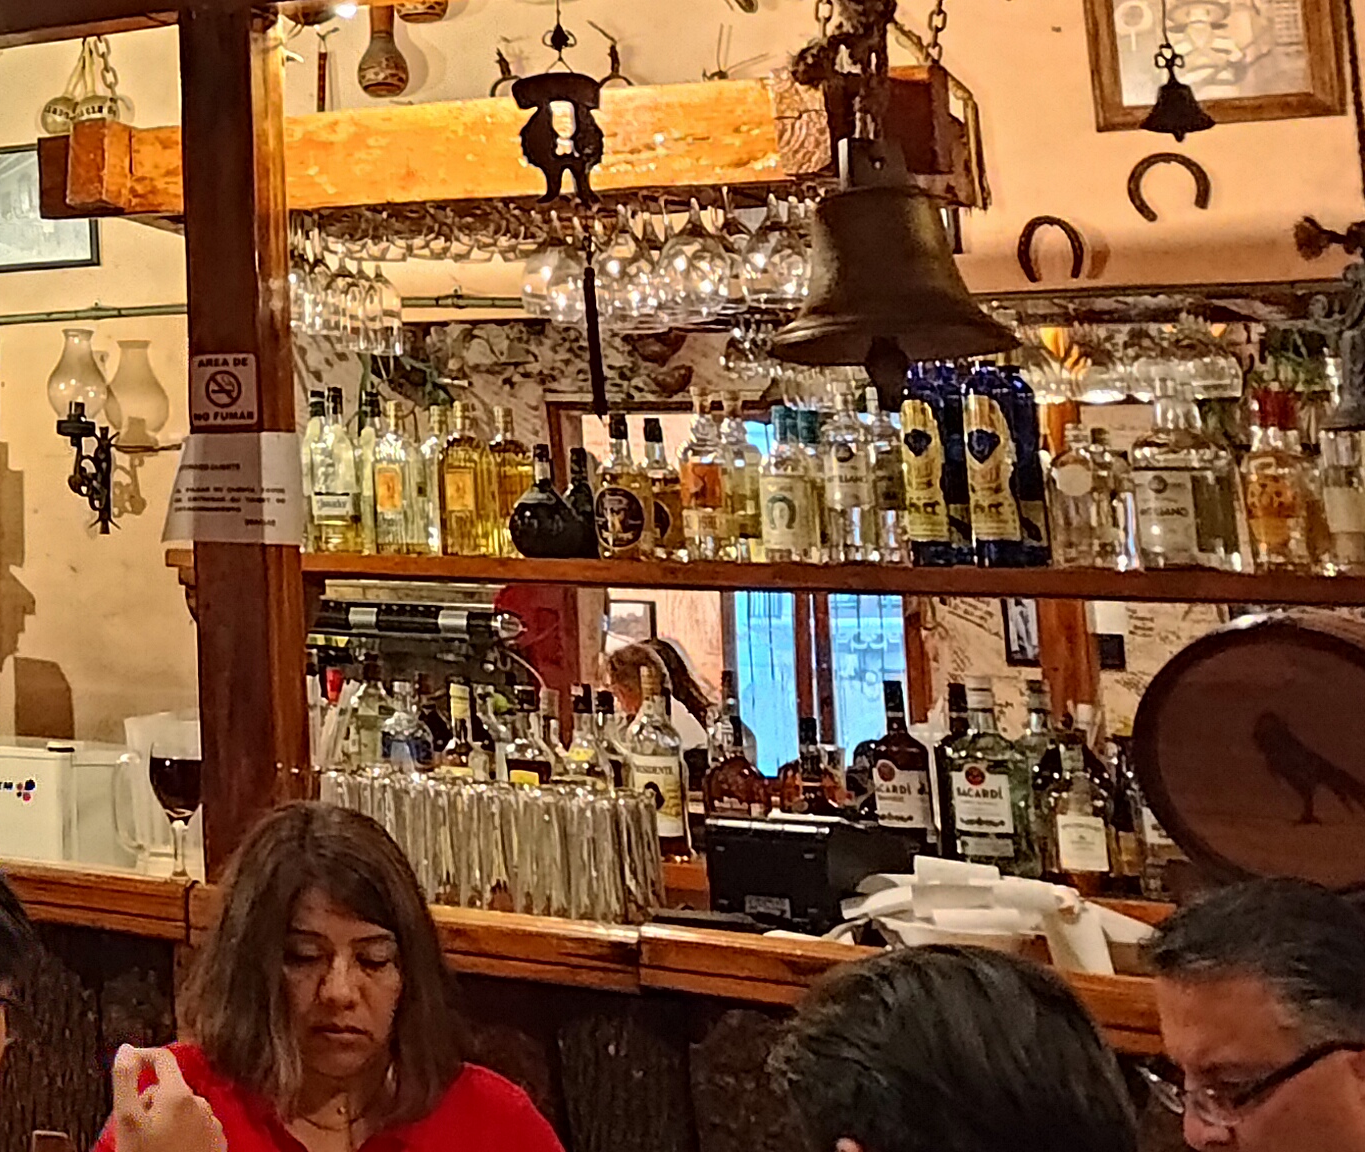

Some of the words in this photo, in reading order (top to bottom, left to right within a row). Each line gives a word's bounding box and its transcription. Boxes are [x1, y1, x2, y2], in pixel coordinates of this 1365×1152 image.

[198, 358, 229, 368] AREA
[233, 357, 249, 367] DE
[194, 412, 210, 421] NO
[213, 411, 254, 421] FUMAR
